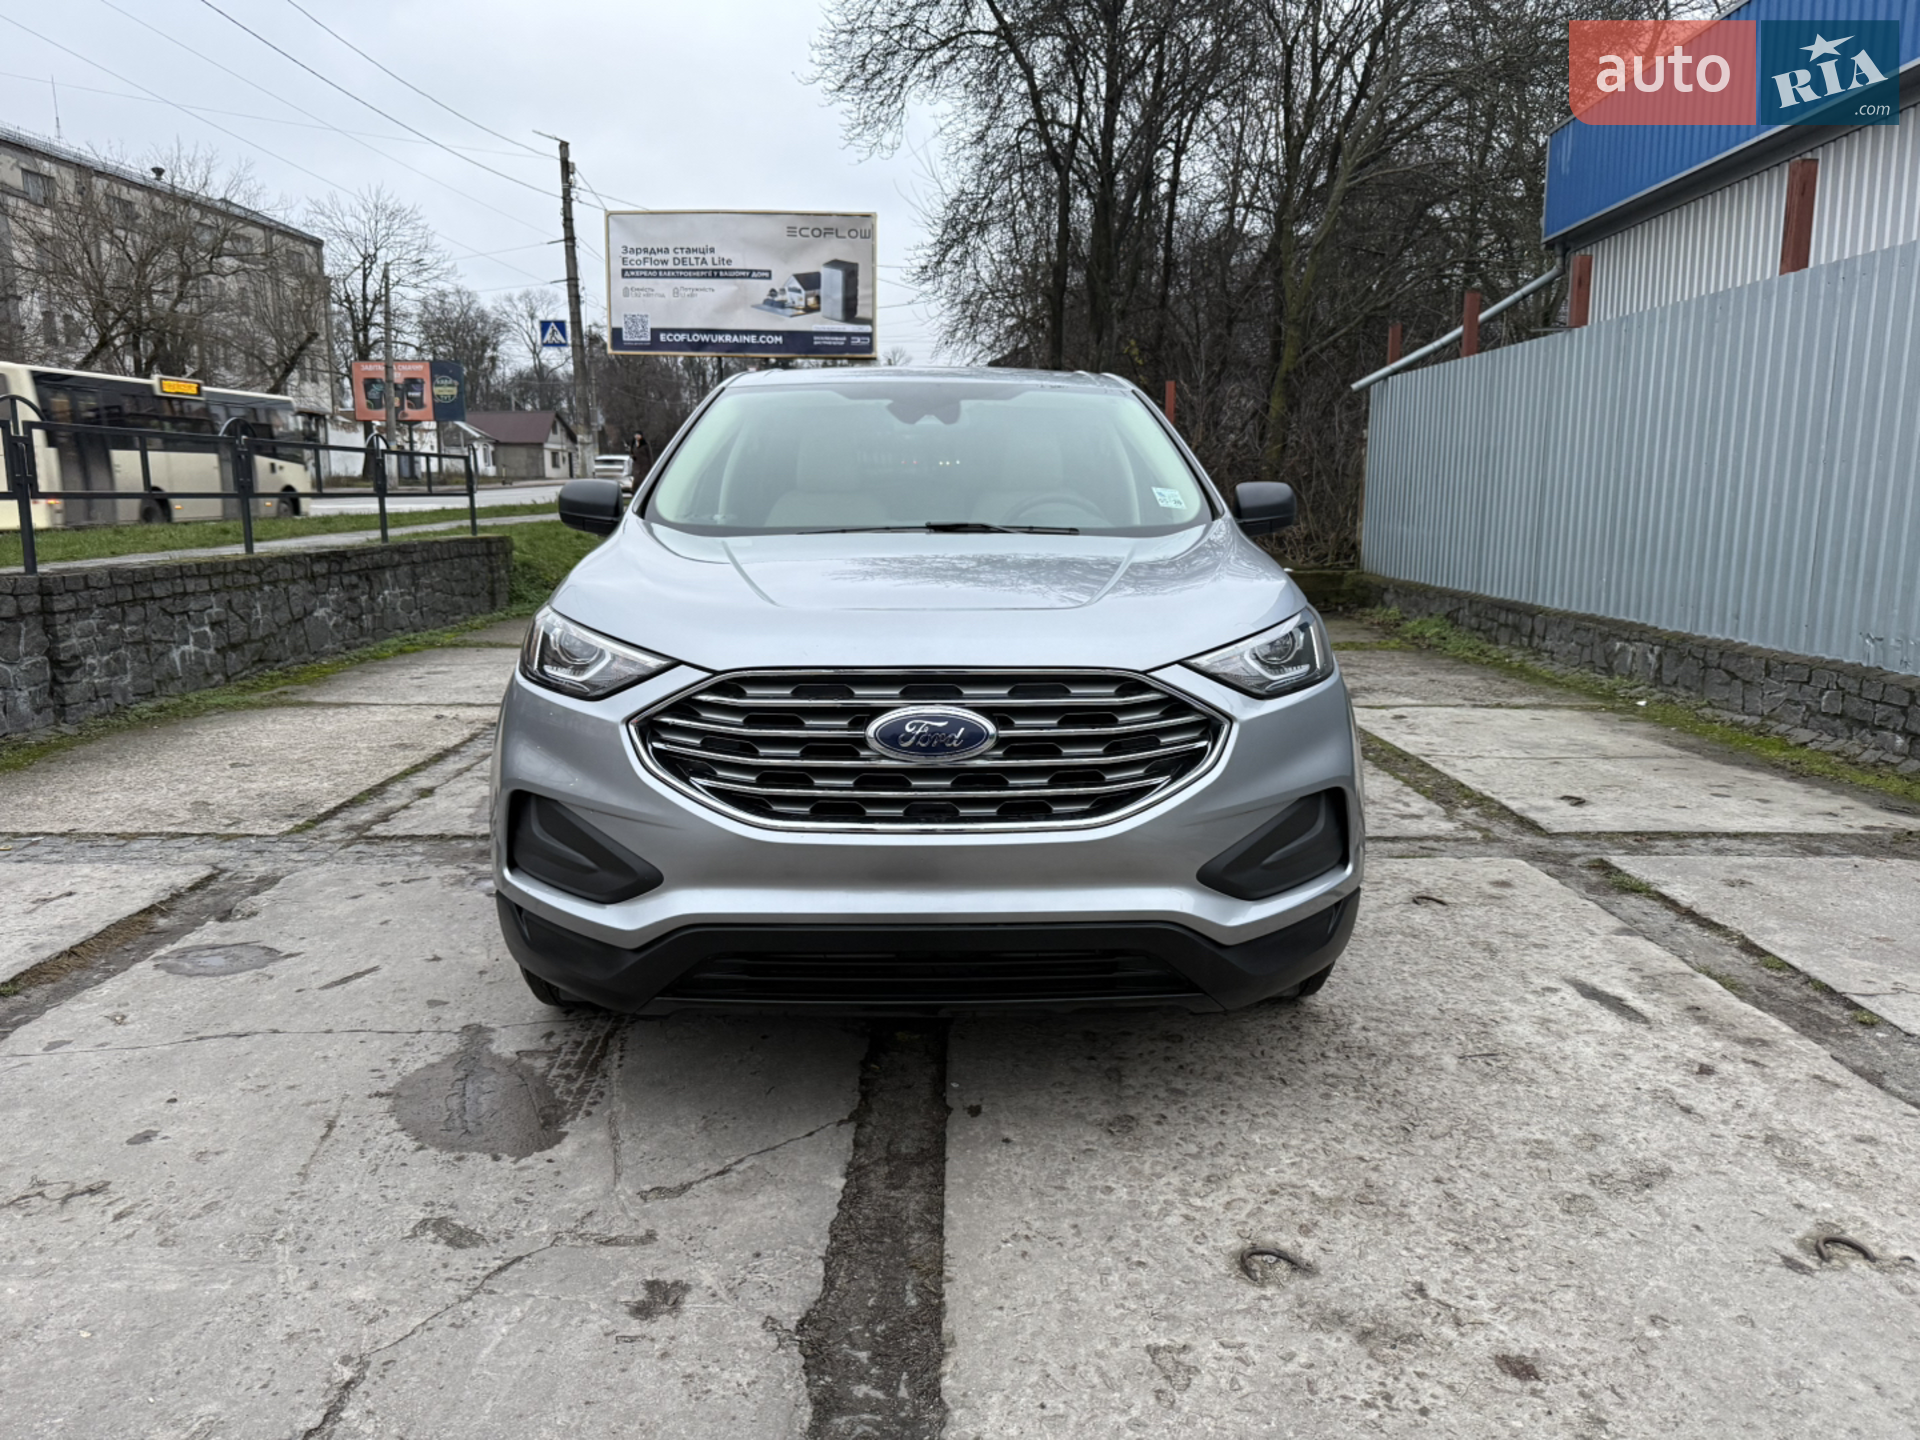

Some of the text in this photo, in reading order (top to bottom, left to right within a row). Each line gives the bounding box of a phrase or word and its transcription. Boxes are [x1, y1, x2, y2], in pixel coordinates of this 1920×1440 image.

[786, 226, 872, 240] ECOFLOW
[621, 244, 715, 256] Зарядна станція
[621, 256, 733, 266] EcoFlow DELTA Lite
[624, 270, 658, 278] ДЖЕРЕЛО
[719, 270, 750, 278] ВАШОМУ
[660, 333, 783, 344] ECOFLOWUKRAINE.COM
[898, 720, 965, 747] Ford
